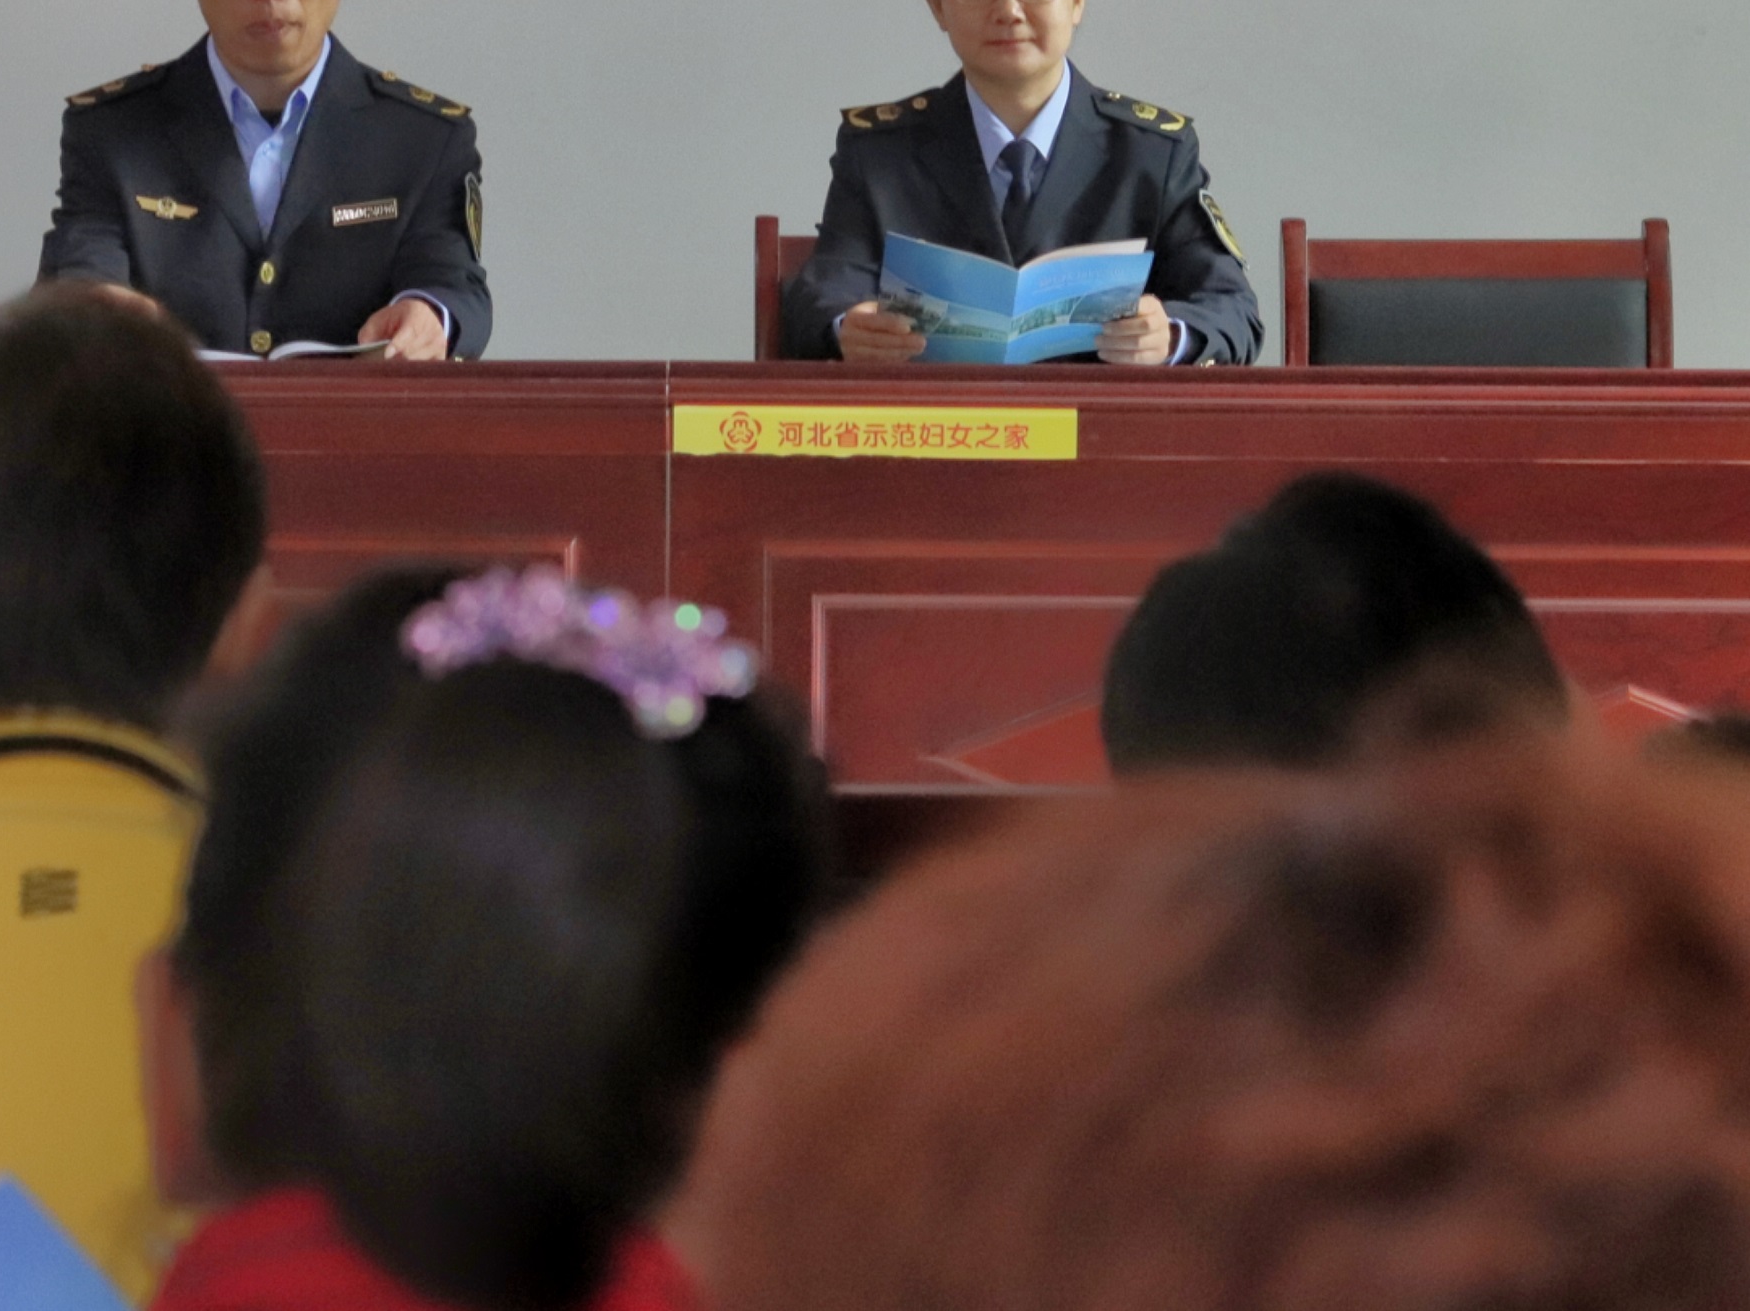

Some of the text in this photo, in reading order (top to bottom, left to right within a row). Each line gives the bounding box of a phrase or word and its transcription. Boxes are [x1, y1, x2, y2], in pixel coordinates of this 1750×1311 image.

[779, 421, 1030, 449] 河北省示范妇女之家
